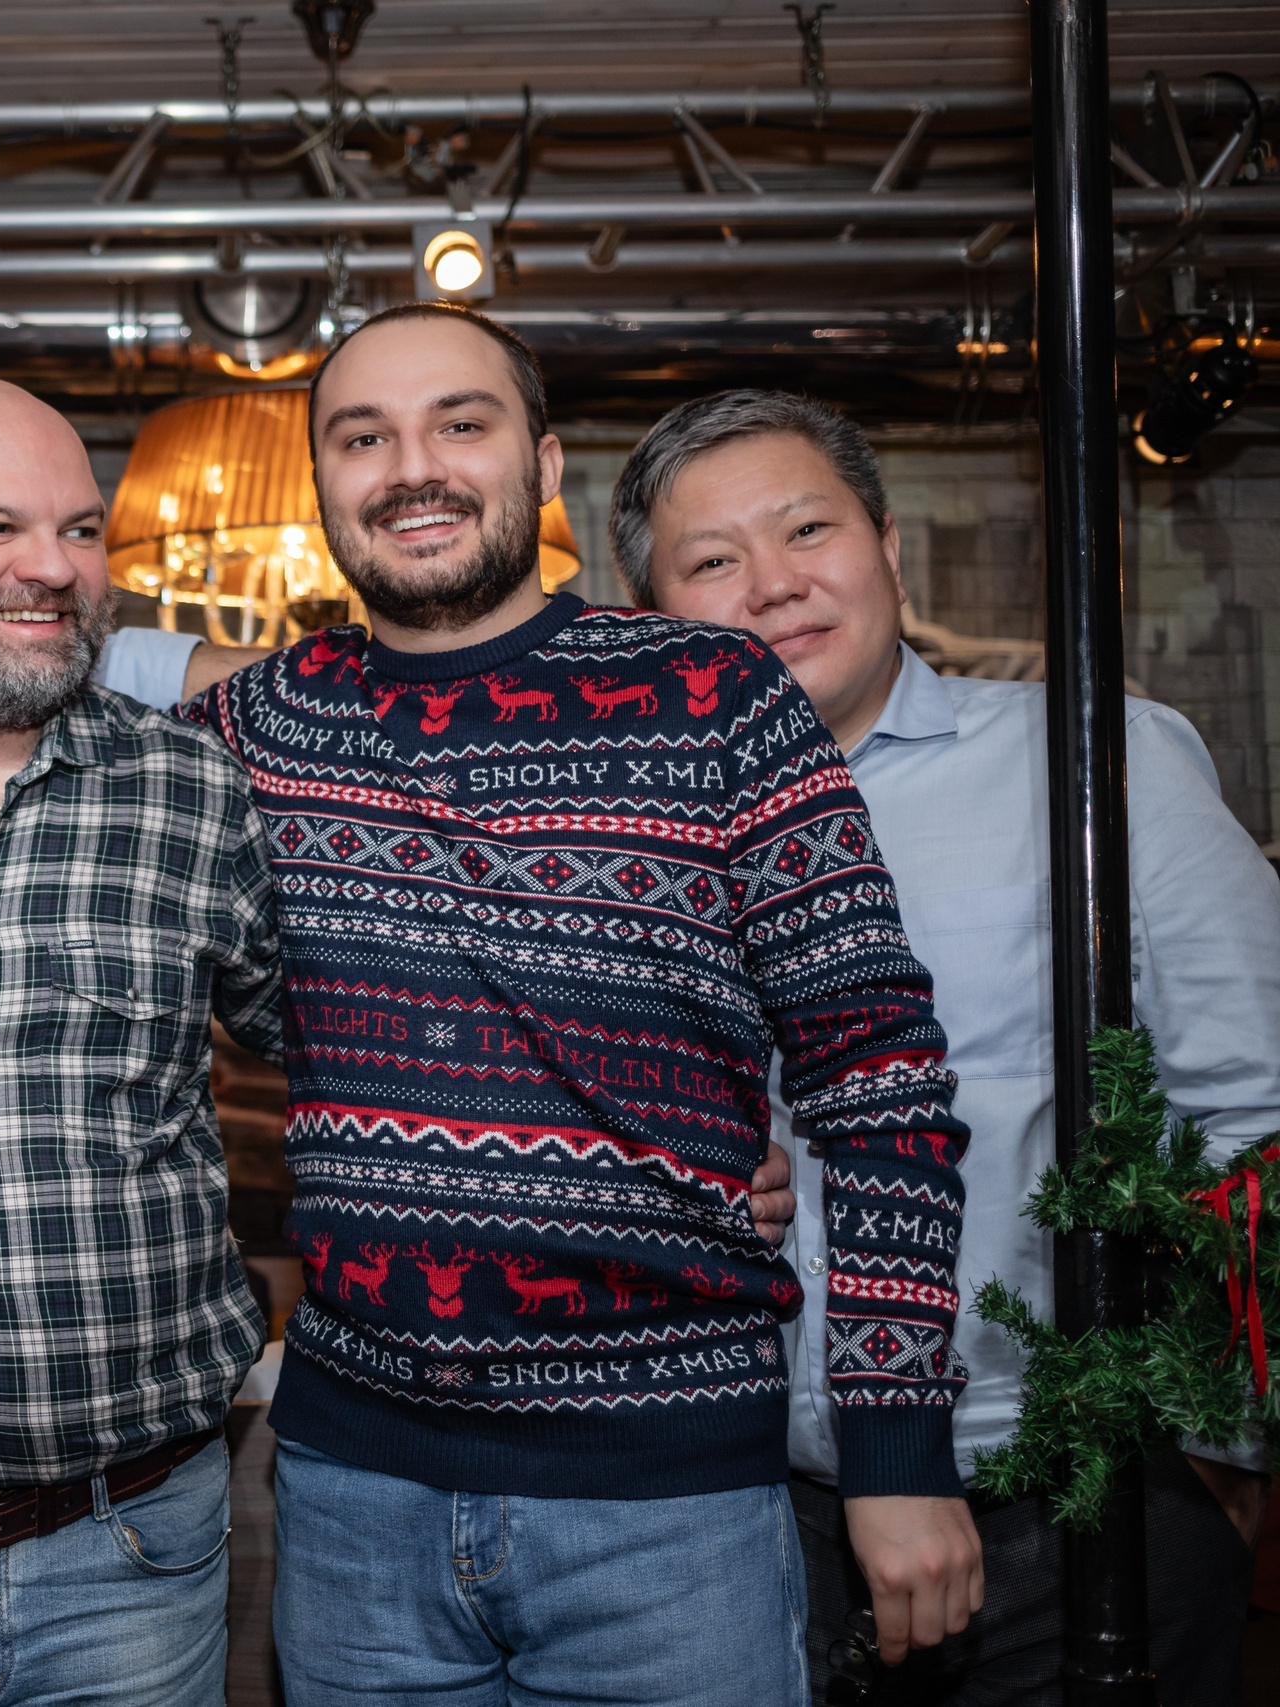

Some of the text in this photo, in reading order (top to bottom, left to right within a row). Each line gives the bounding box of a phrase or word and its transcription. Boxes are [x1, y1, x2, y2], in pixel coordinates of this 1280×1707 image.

[734, 700, 815, 774] X-MAS
[470, 761, 609, 792] SNOWY
[308, 1005, 408, 1041] LIGHTS
[673, 1066, 770, 1123] LIGHTS
[856, 1208, 956, 1254] X-MAS
[332, 1326, 413, 1380] X-MAS
[488, 1361, 632, 1387] SNOWY
[648, 1345, 751, 1379] X-MAS
